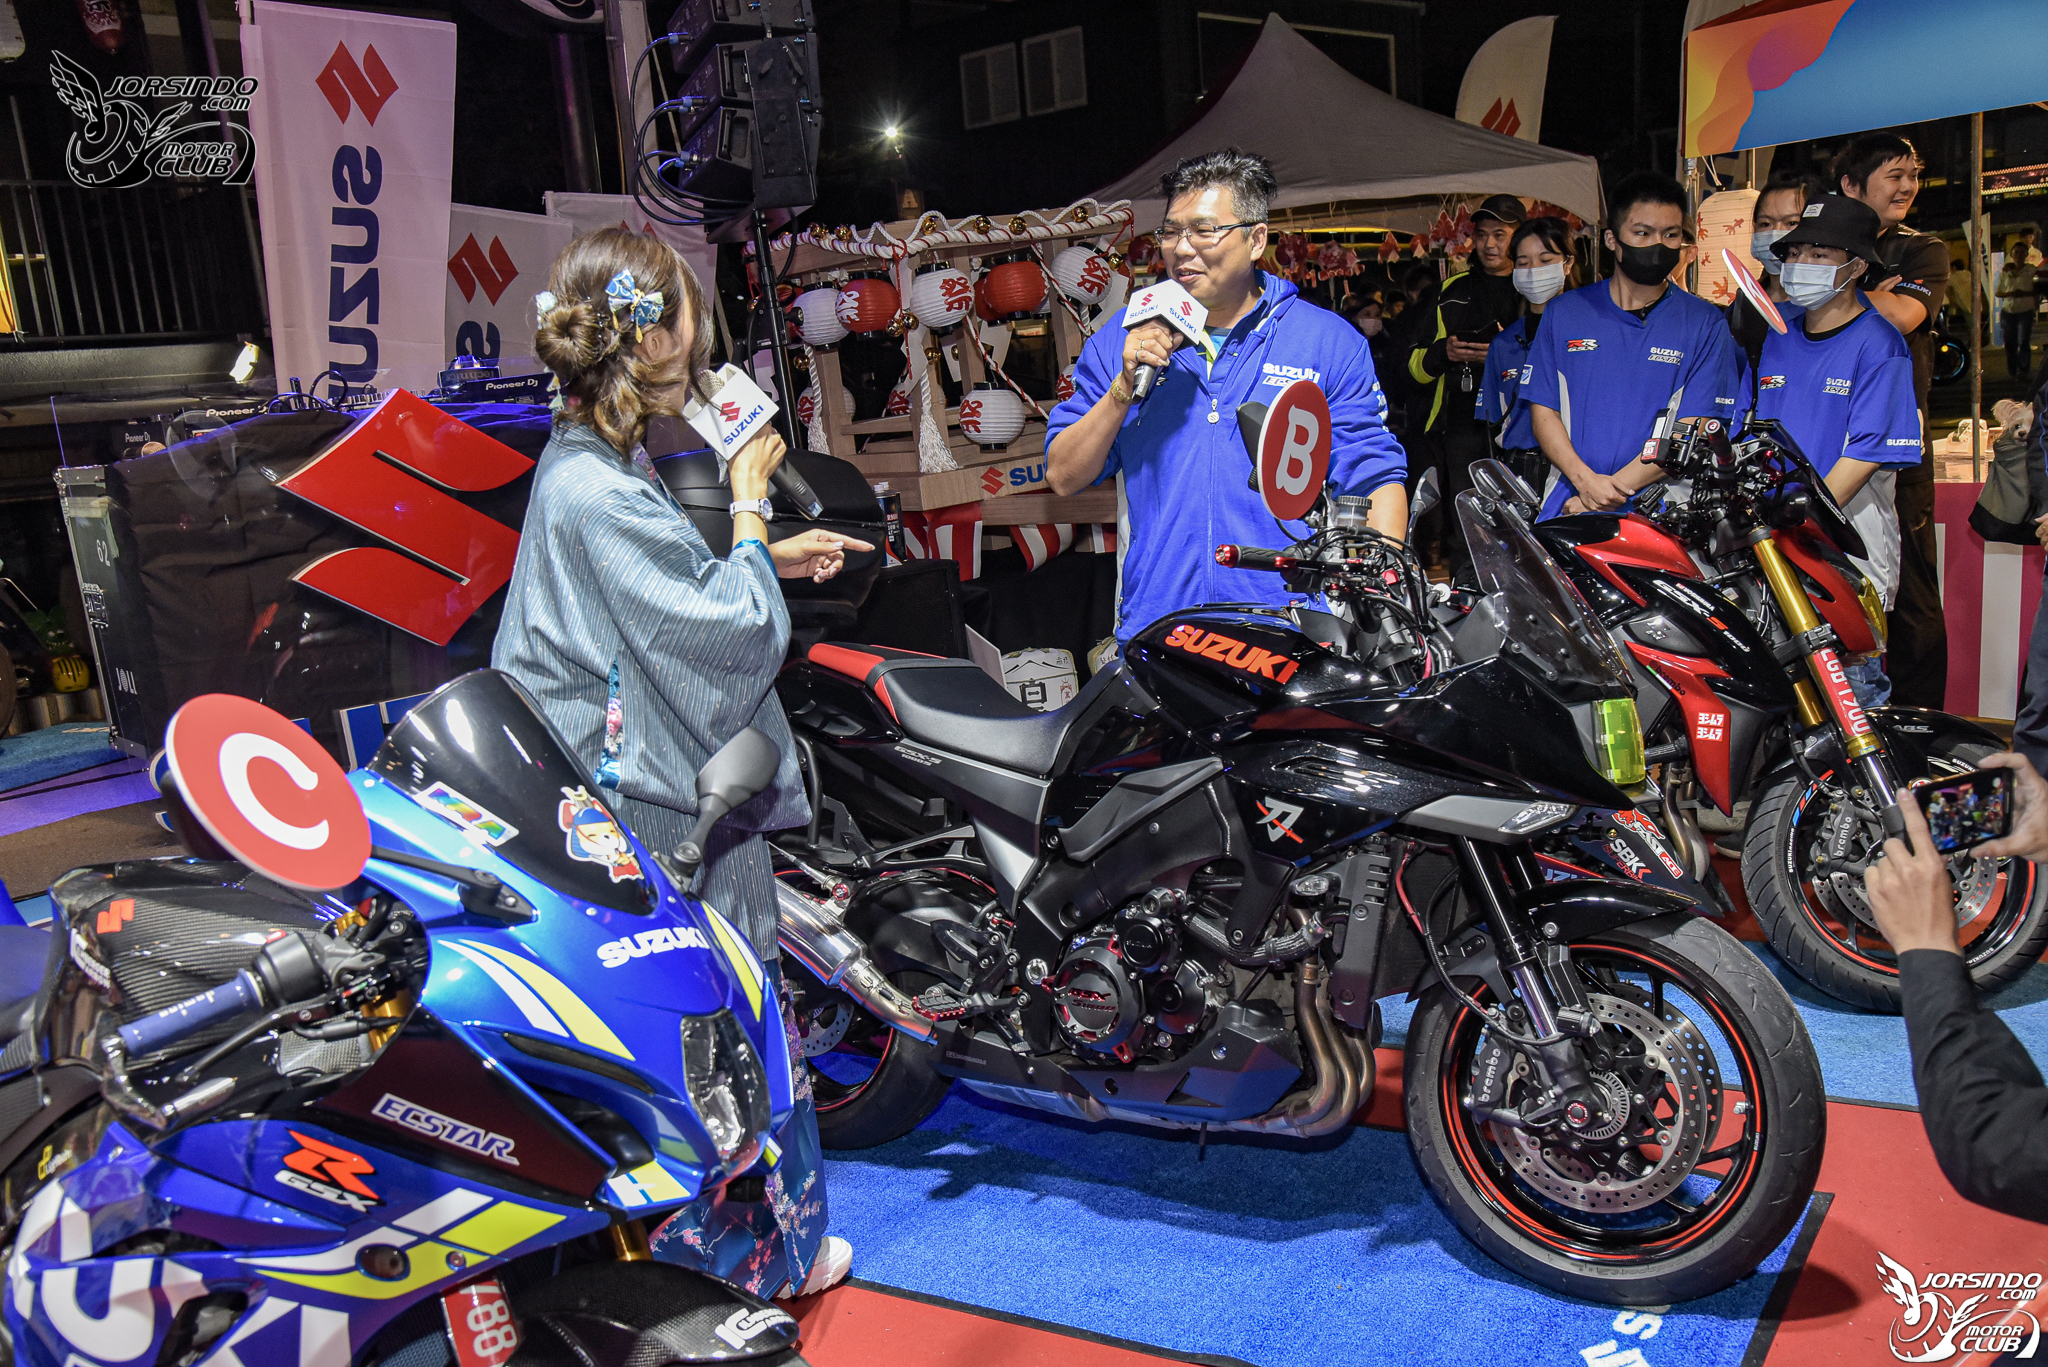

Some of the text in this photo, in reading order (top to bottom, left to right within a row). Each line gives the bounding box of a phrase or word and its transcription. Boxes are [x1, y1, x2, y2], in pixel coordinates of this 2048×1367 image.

[1896, 281, 1932, 297] SUZUKI
[1129, 304, 1158, 318] SUZUKI
[1169, 307, 1197, 334] SUZUKI
[1650, 346, 1684, 358] SUZUKI
[485, 380, 525, 391] Pioneer
[1262, 363, 1320, 384] SUZUKI
[205, 408, 255, 418] Pioneer
[723, 404, 764, 445] SUZUKI
[125, 432, 143, 443] Pioneer
[1275, 404, 1320, 496] B
[1886, 438, 1920, 446] SUZUKI
[1684, 587, 1716, 611] YOSHIMURA
[1165, 624, 1300, 685] SUZUKI
[1656, 665, 1686, 695] brembo
[1696, 727, 1723, 740] ヨシムラ
[1698, 713, 1724, 726] ヨシムラ
[1952, 758, 1976, 773] SUZUKI
[219, 732, 329, 851] C
[1834, 816, 1852, 857] brembo
[1610, 838, 1647, 873] SBK
[597, 926, 710, 968] SUZUKI
[1478, 1048, 1501, 1103] brembo
[371, 1092, 520, 1166] ECSTAR
[283, 1128, 380, 1200] R
[1458, 1129, 1498, 1197] KATANA
[274, 1169, 379, 1213] GSX
